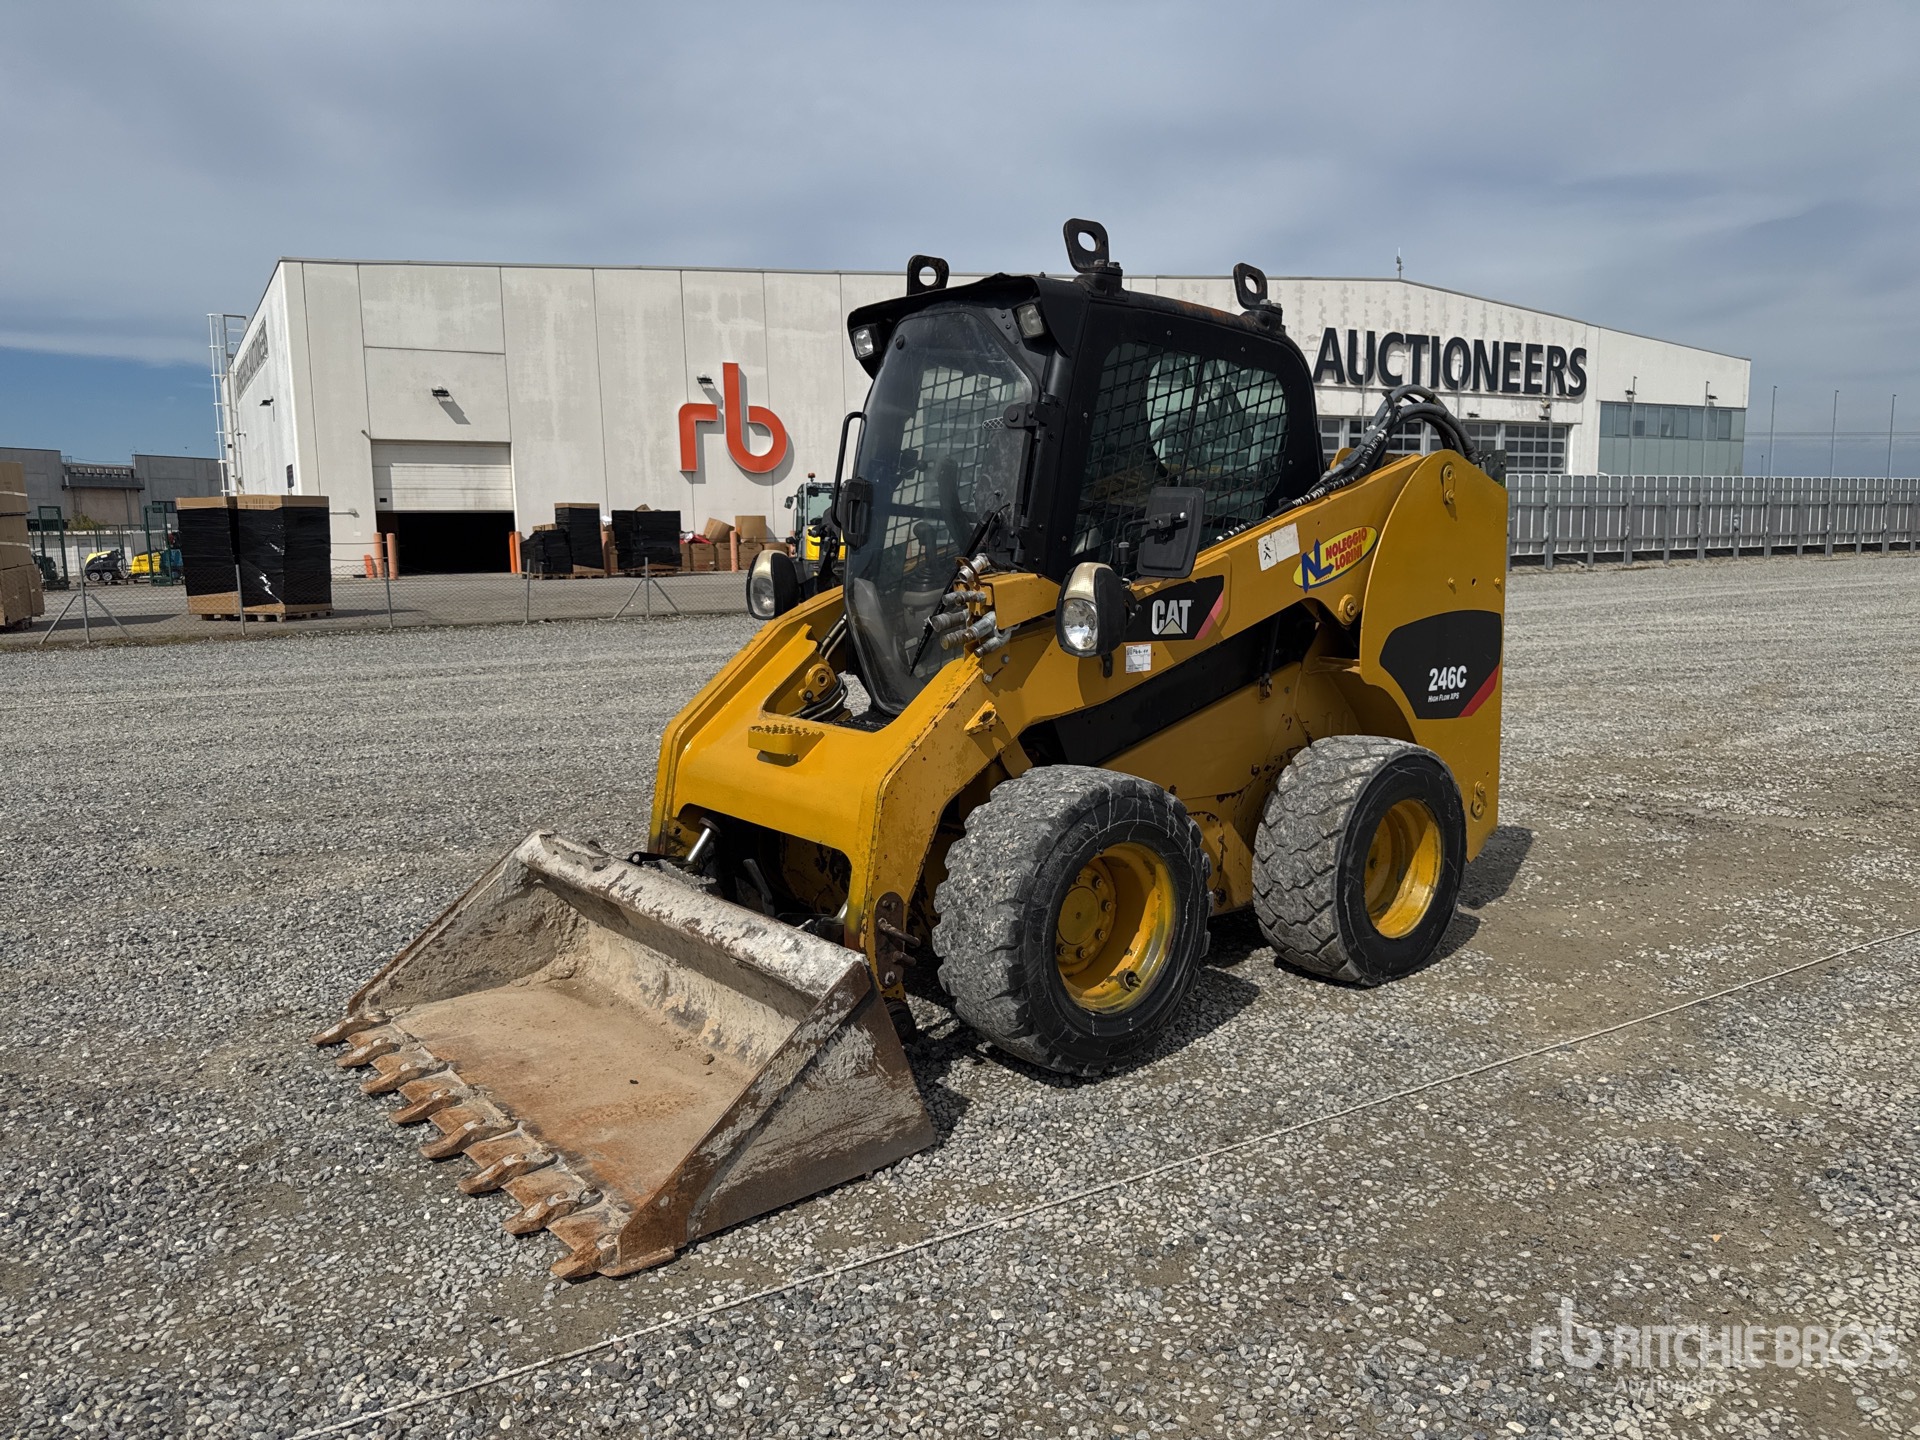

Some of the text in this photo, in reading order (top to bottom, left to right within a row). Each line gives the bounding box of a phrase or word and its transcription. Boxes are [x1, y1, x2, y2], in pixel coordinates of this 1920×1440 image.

[1312, 327, 1587, 396] AUCTIONEERS
[678, 362, 787, 473] rb
[1325, 527, 1367, 561] NOLEGGIO
[1335, 544, 1362, 571] LORINI
[1151, 599, 1192, 635] CAT
[1428, 665, 1467, 692] 246C
